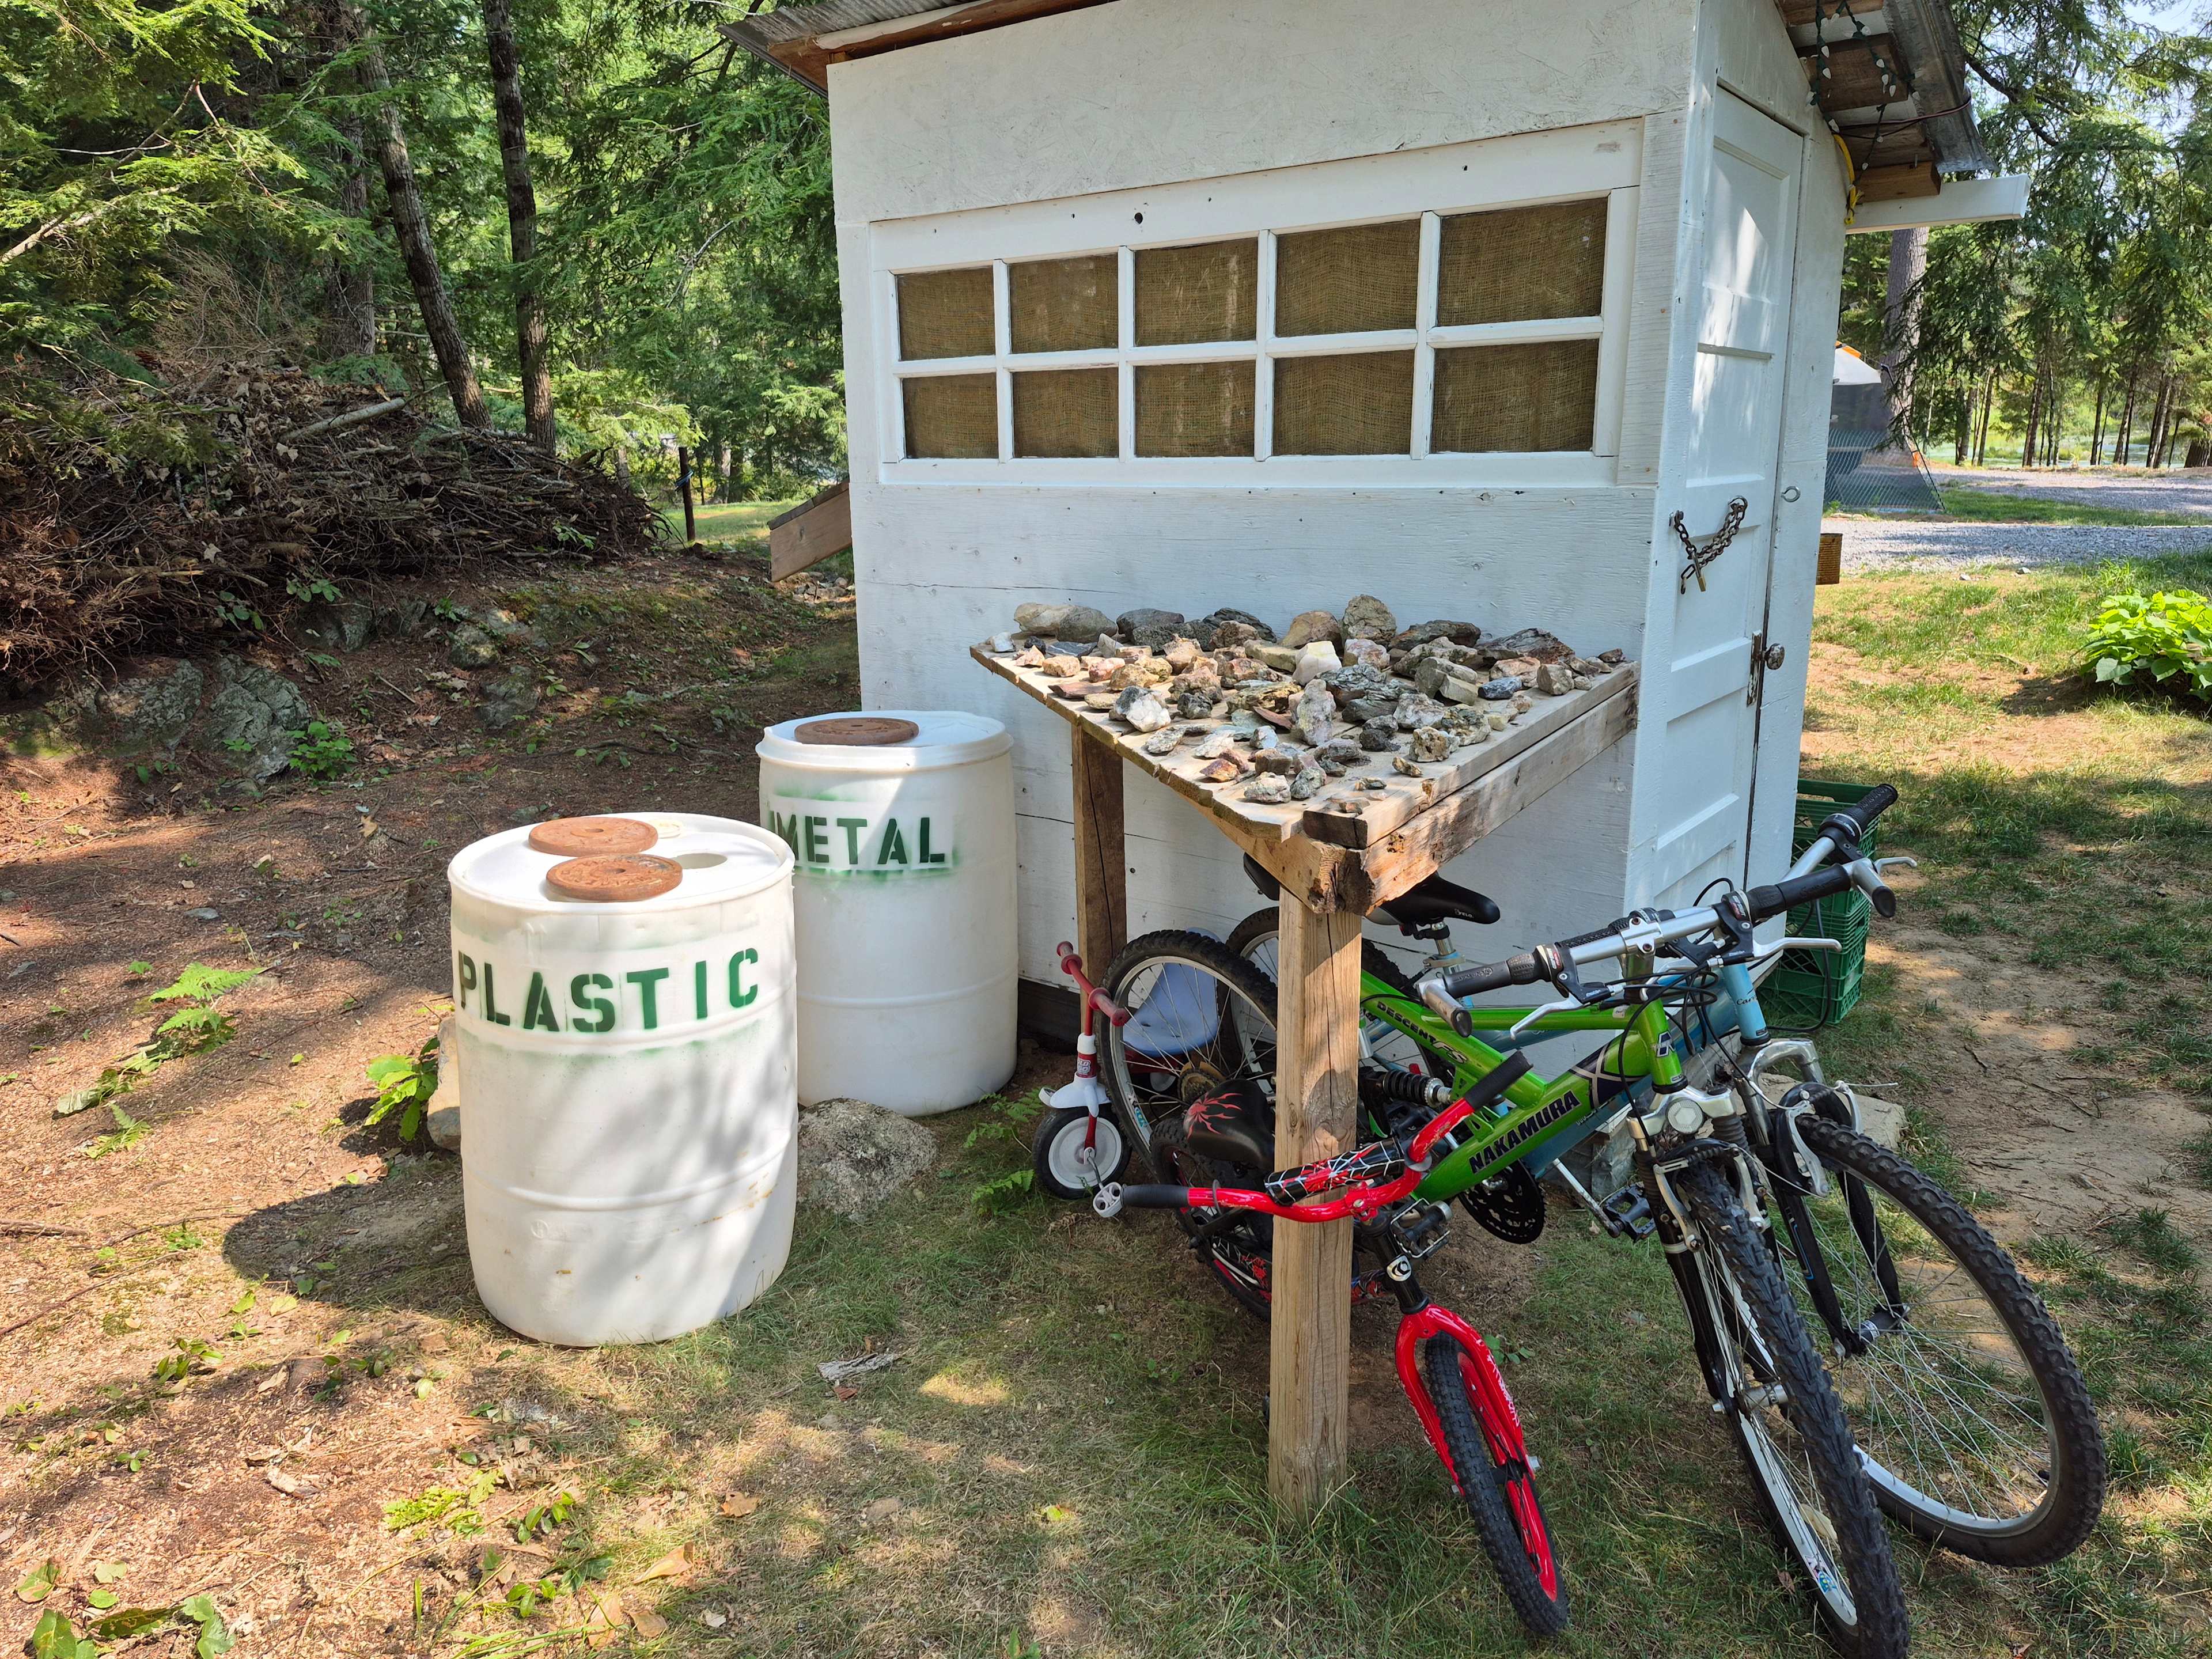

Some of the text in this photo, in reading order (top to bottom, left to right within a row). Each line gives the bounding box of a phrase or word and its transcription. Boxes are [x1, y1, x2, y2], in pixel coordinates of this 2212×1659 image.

[768, 811, 945, 865] METAL
[459, 948, 758, 1032] PLASTIC
[1377, 1001, 1468, 1064] DESCENT FS
[1468, 1089, 1582, 1175] NAKAMURA
